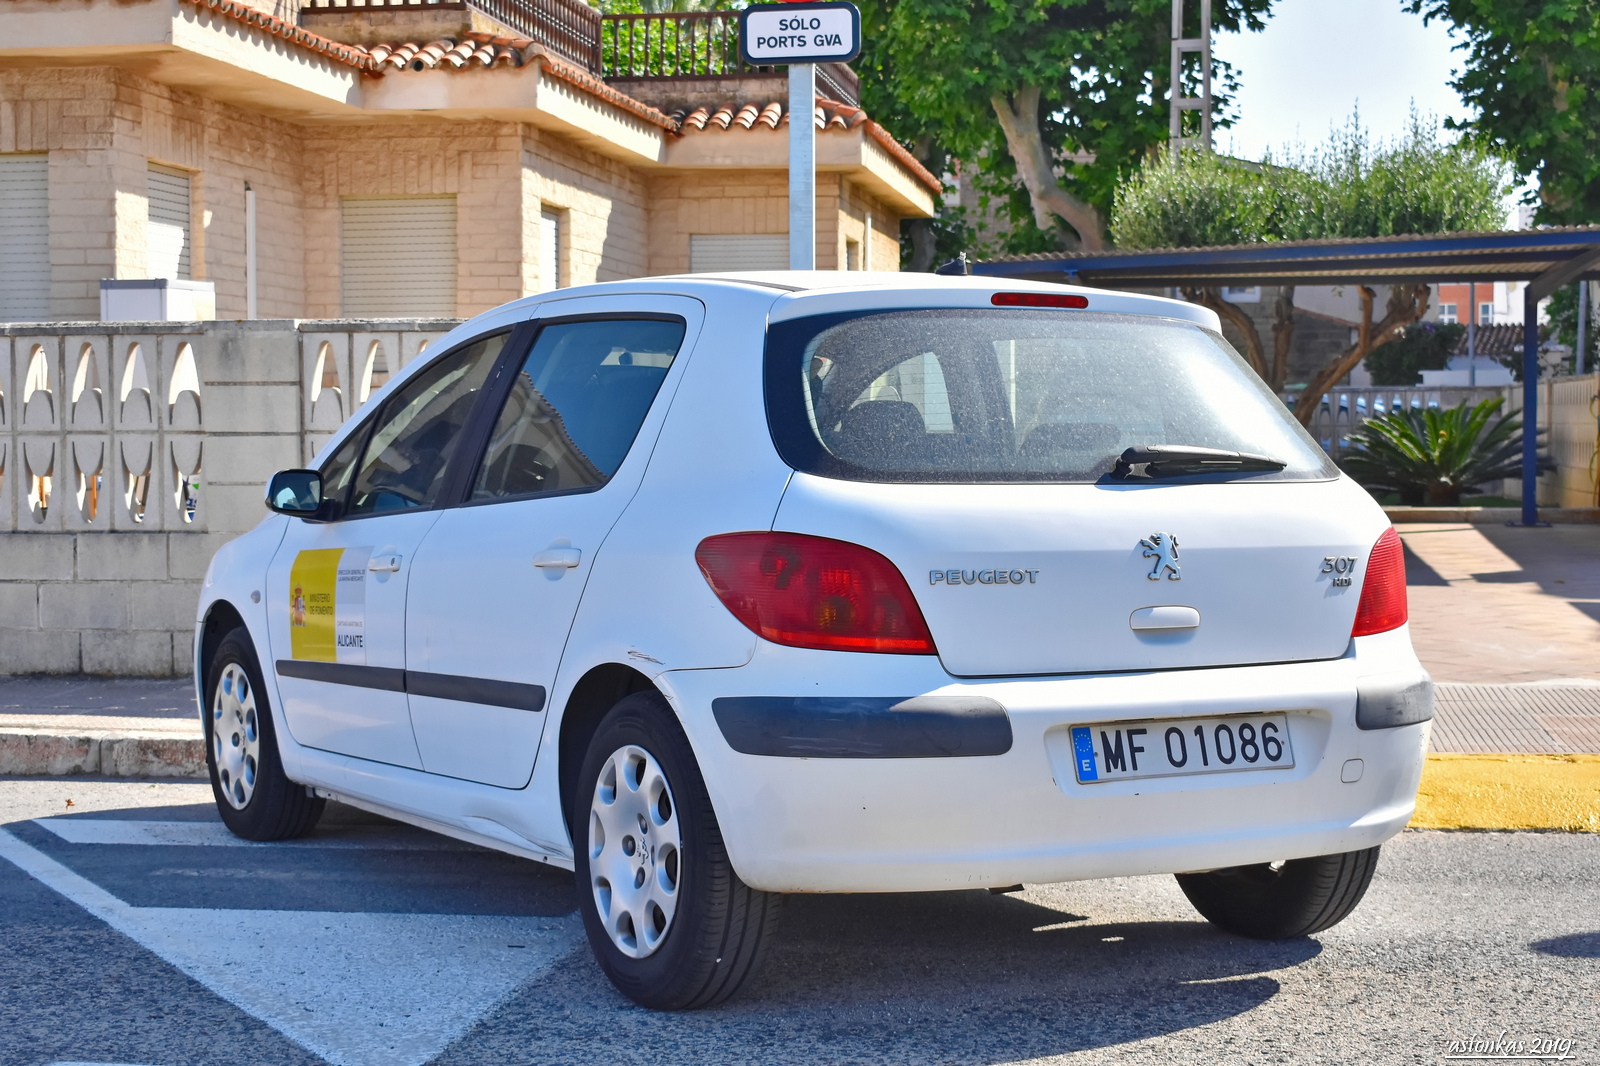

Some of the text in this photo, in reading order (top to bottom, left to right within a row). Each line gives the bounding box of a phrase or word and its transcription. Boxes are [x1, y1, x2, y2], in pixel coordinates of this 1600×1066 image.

[779, 15, 821, 31] SÓLO
[757, 34, 842, 48] PORTS GVA
[1321, 556, 1358, 574] 307
[929, 568, 1040, 585] PEUGEOT
[337, 634, 363, 647] ALICANTE
[1100, 722, 1283, 773] MF 01086
[1082, 759, 1092, 771] E
